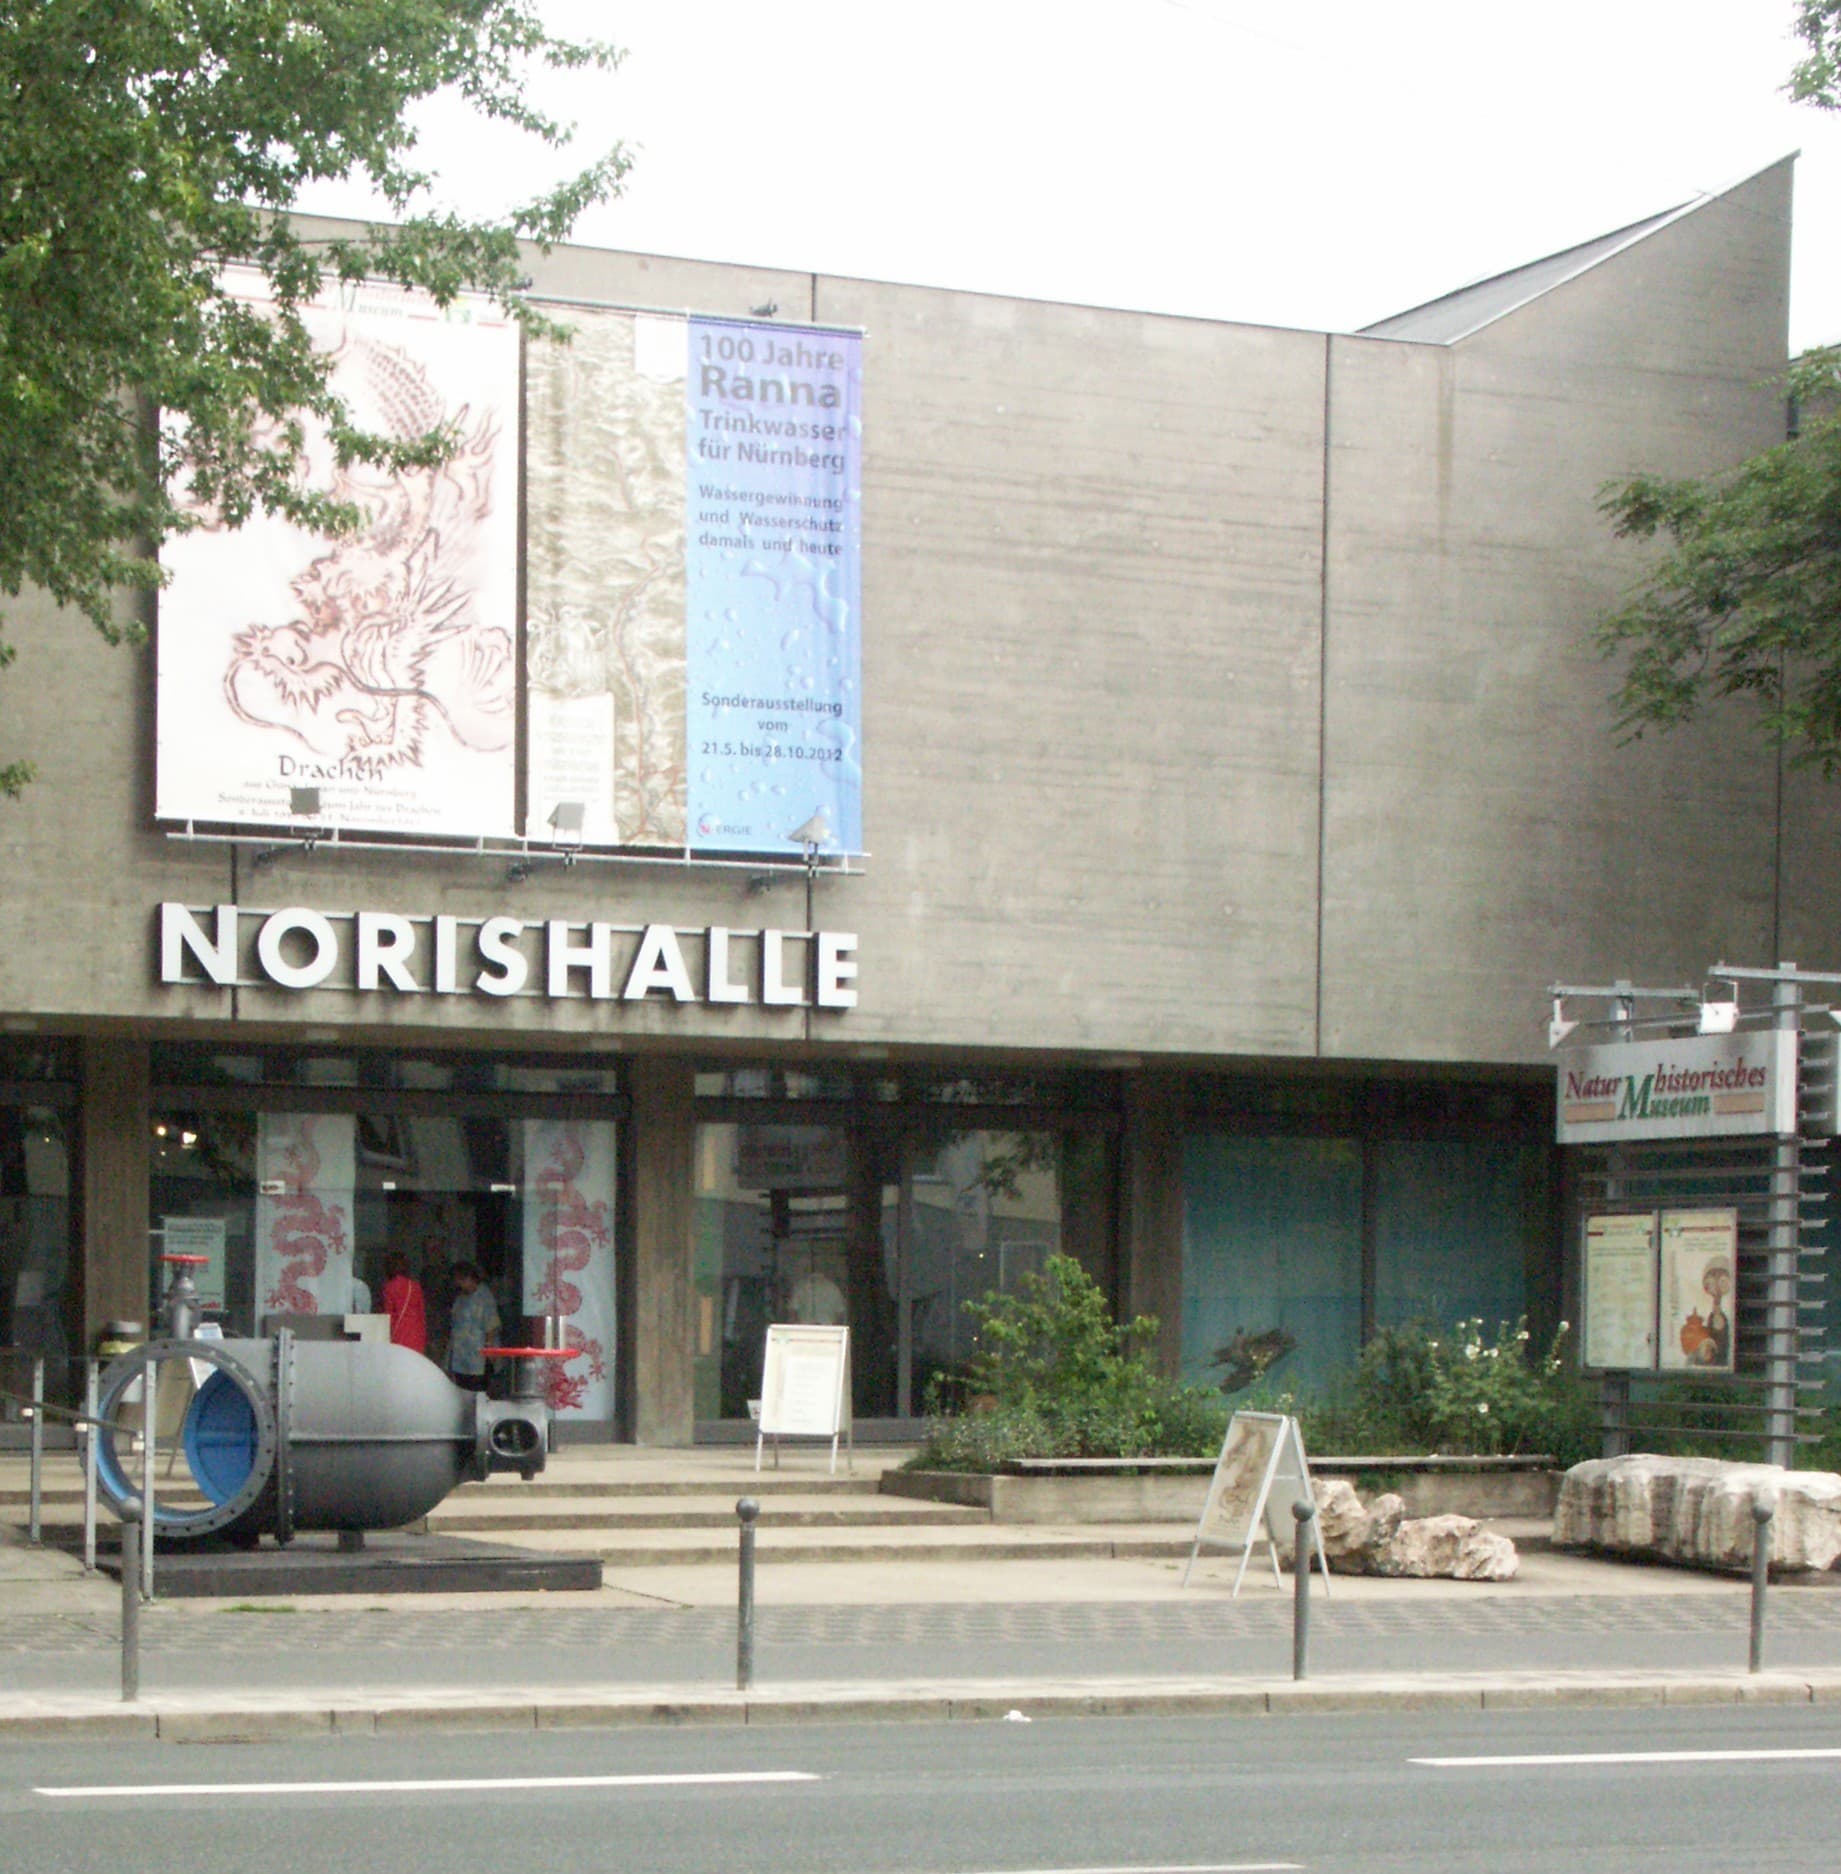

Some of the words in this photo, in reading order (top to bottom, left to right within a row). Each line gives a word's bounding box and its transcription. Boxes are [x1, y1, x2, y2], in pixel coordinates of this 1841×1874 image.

[701, 333, 755, 363] 100
[761, 339, 845, 371] Jahre
[701, 364, 842, 409] Ranna
[702, 408, 847, 441] Trinkwasser
[698, 438, 732, 462] für
[737, 440, 845, 475] Nürnberg
[699, 484, 844, 513] Wassergewinnung
[699, 508, 729, 525] und
[739, 511, 843, 534] Wasserschutz
[699, 530, 755, 550] damals
[762, 535, 793, 552] und
[799, 537, 842, 557] heute
[701, 691, 843, 717] Sonderausstellung
[757, 720, 789, 733] vom
[702, 741, 737, 757] 21.5.
[740, 742, 761, 758] bis
[764, 745, 843, 762] 28.10.2012
[278, 753, 384, 782] Drachen
[161, 901, 859, 1008] NORISHALLE
[1565, 1070, 1623, 1099] Natur
[1654, 1057, 1767, 1094] historisches
[1617, 1072, 1711, 1121] Museum
